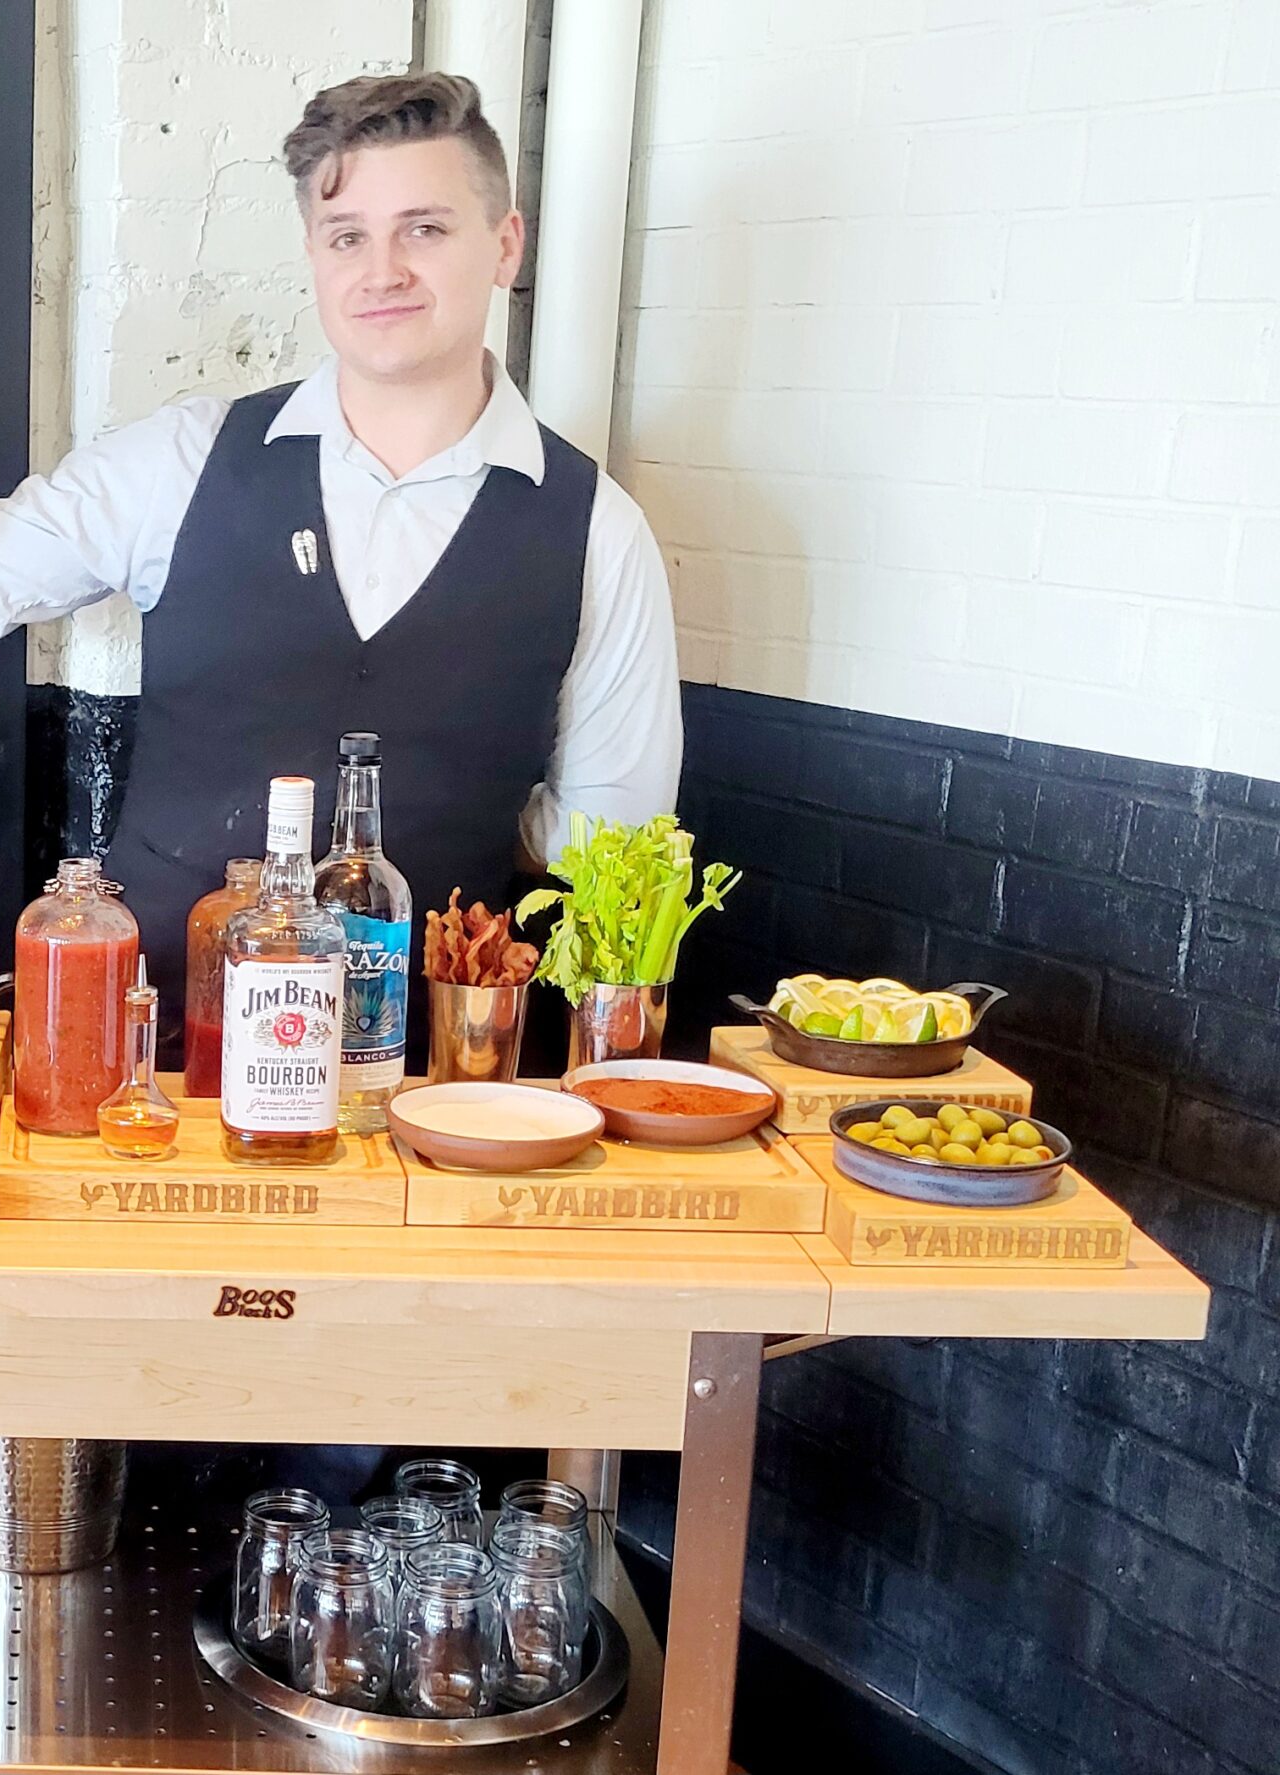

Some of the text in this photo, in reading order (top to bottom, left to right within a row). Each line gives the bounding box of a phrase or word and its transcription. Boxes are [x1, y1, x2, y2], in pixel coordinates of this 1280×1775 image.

[343, 948, 407, 975] RAZÓN
[242, 980, 337, 1020] JIM BEAM
[246, 1065, 327, 1085] BOURBON
[257, 1057, 319, 1065] KENTUCKY STRAIGHT
[269, 1086, 305, 1096] WHISKEY
[110, 1181, 319, 1214] YARDBIRD
[528, 1185, 740, 1220] YARDBIRD
[900, 1225, 1124, 1260] YARDBIRD
